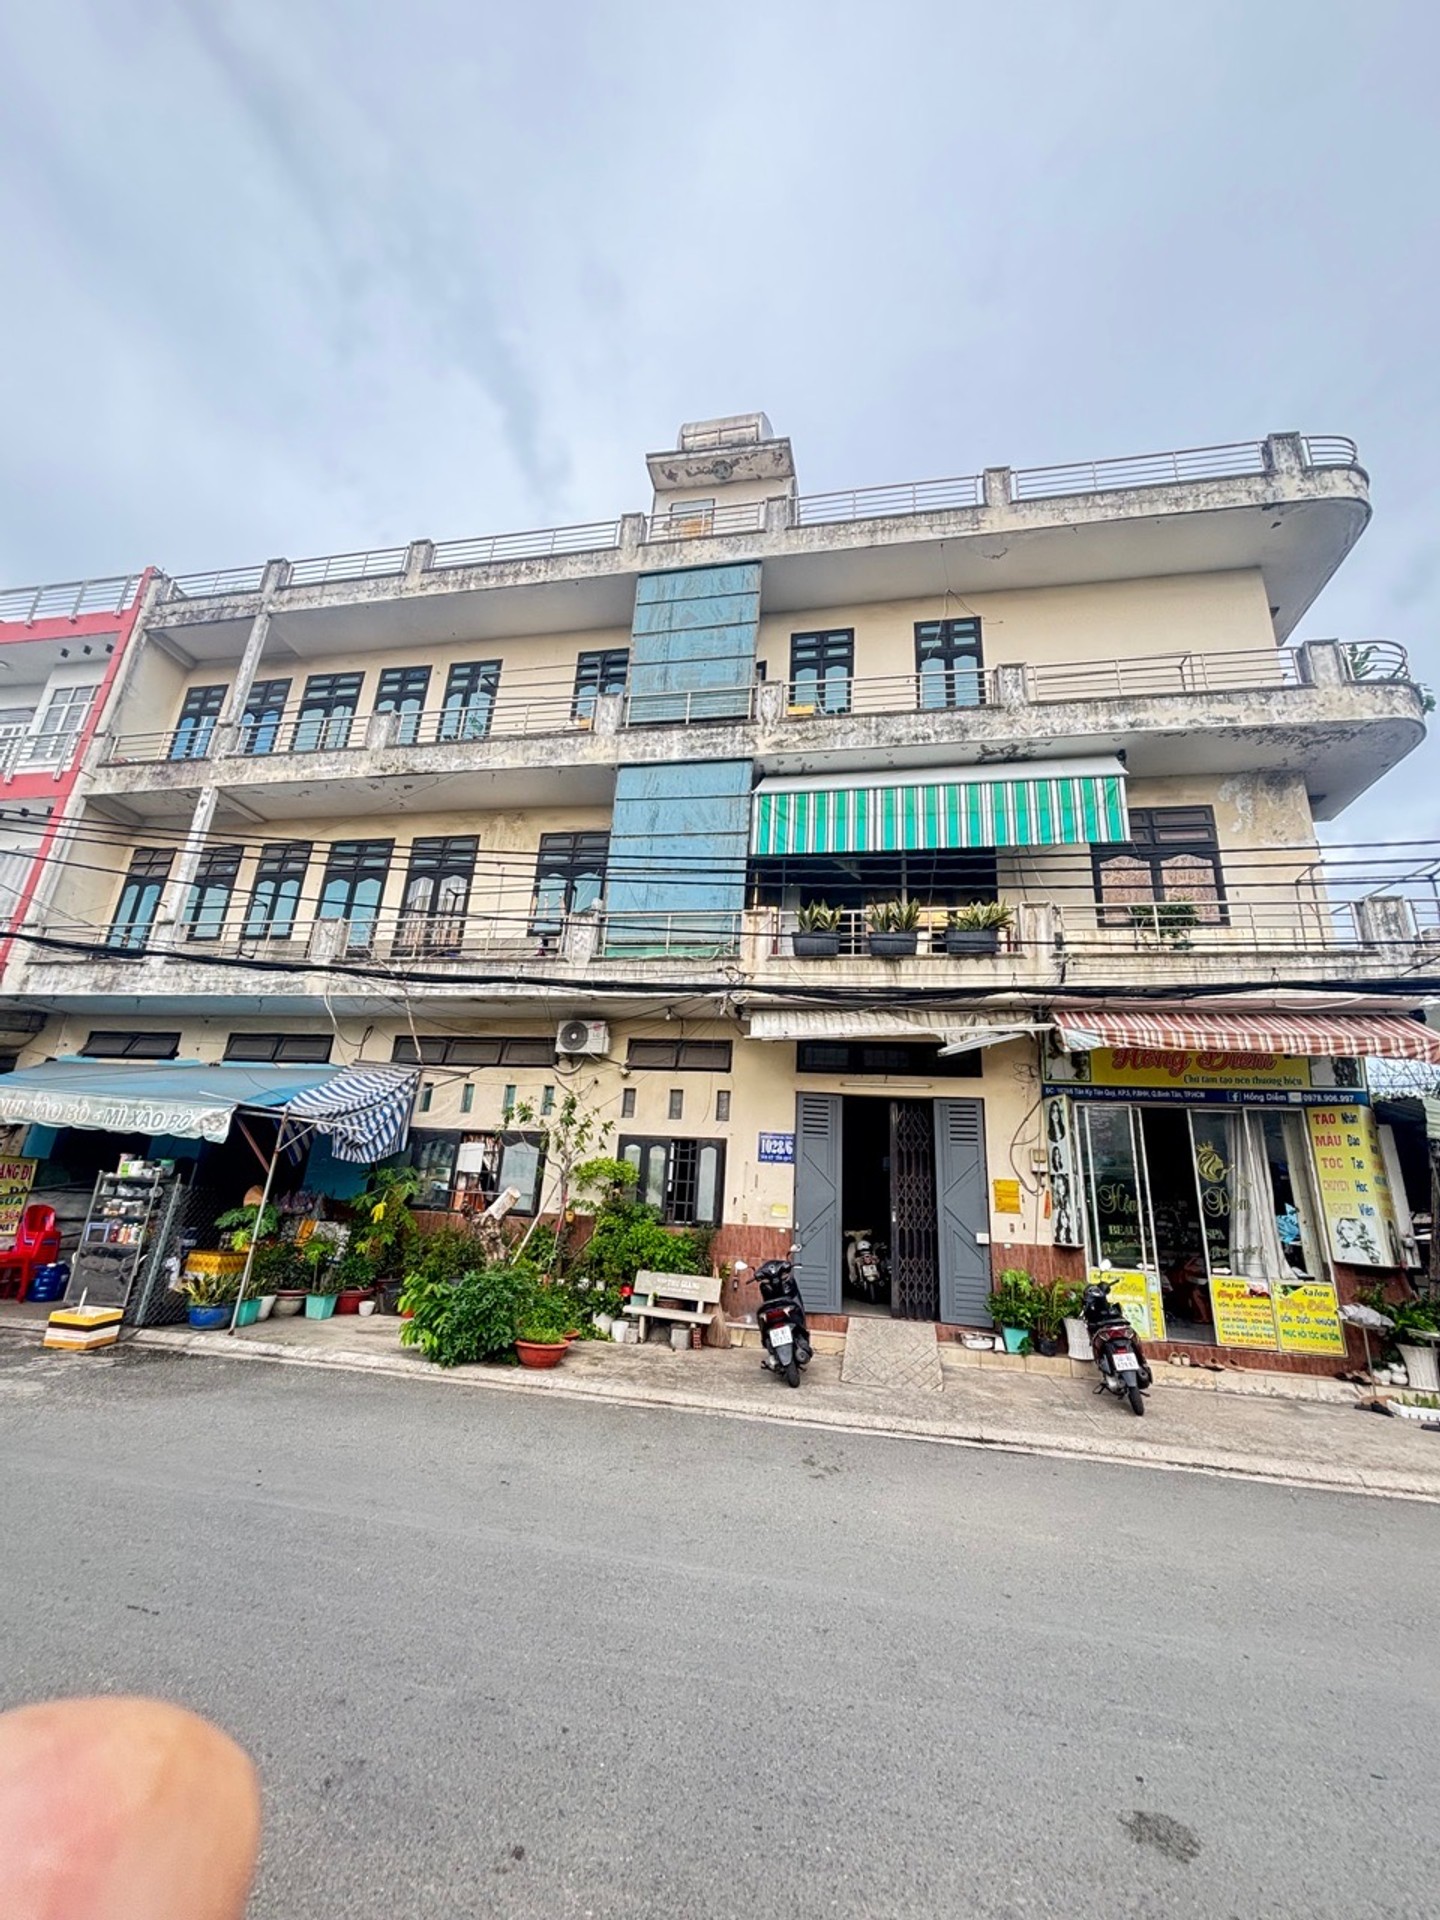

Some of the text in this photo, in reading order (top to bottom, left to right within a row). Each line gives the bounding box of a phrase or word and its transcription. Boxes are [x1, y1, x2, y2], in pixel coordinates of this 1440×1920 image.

[65, 1100, 91, 1122] BÒ
[104, 1104, 129, 1126] MÌ
[129, 1103, 166, 1129] XÀO
[166, 1109, 195, 1129] BÒ
[1313, 1112, 1336, 1127] TẠO
[1220, 1281, 1245, 1289] Salon
[1302, 1288, 1330, 1297] Salon
